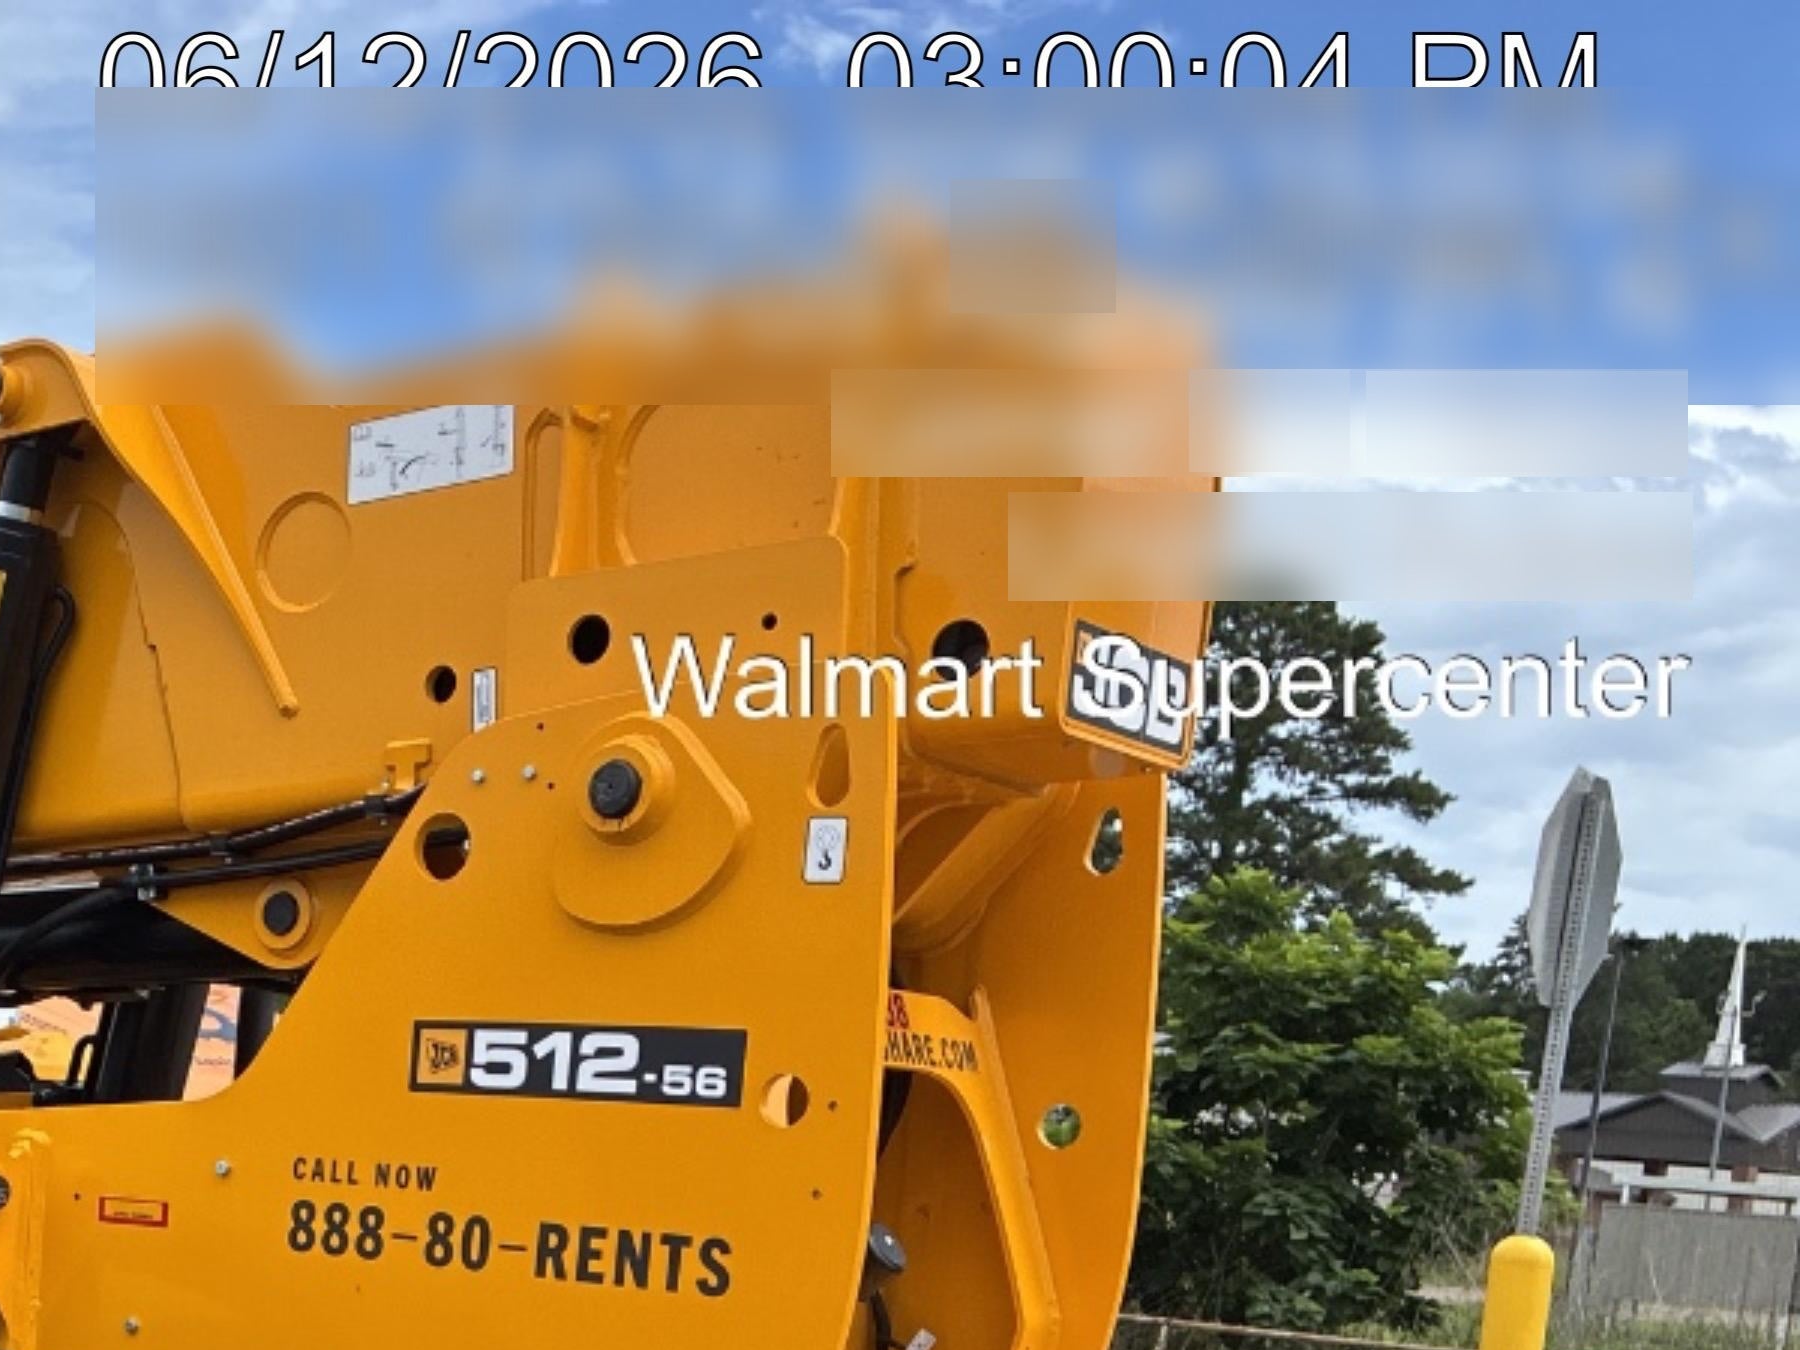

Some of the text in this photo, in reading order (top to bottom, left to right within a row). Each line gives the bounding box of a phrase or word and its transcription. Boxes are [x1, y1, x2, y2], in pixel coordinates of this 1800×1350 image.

[469, 1028, 728, 1099] 512-56
[293, 1157, 438, 1191] CALL NOW
[287, 1198, 732, 1298] 888-80-RENTS
